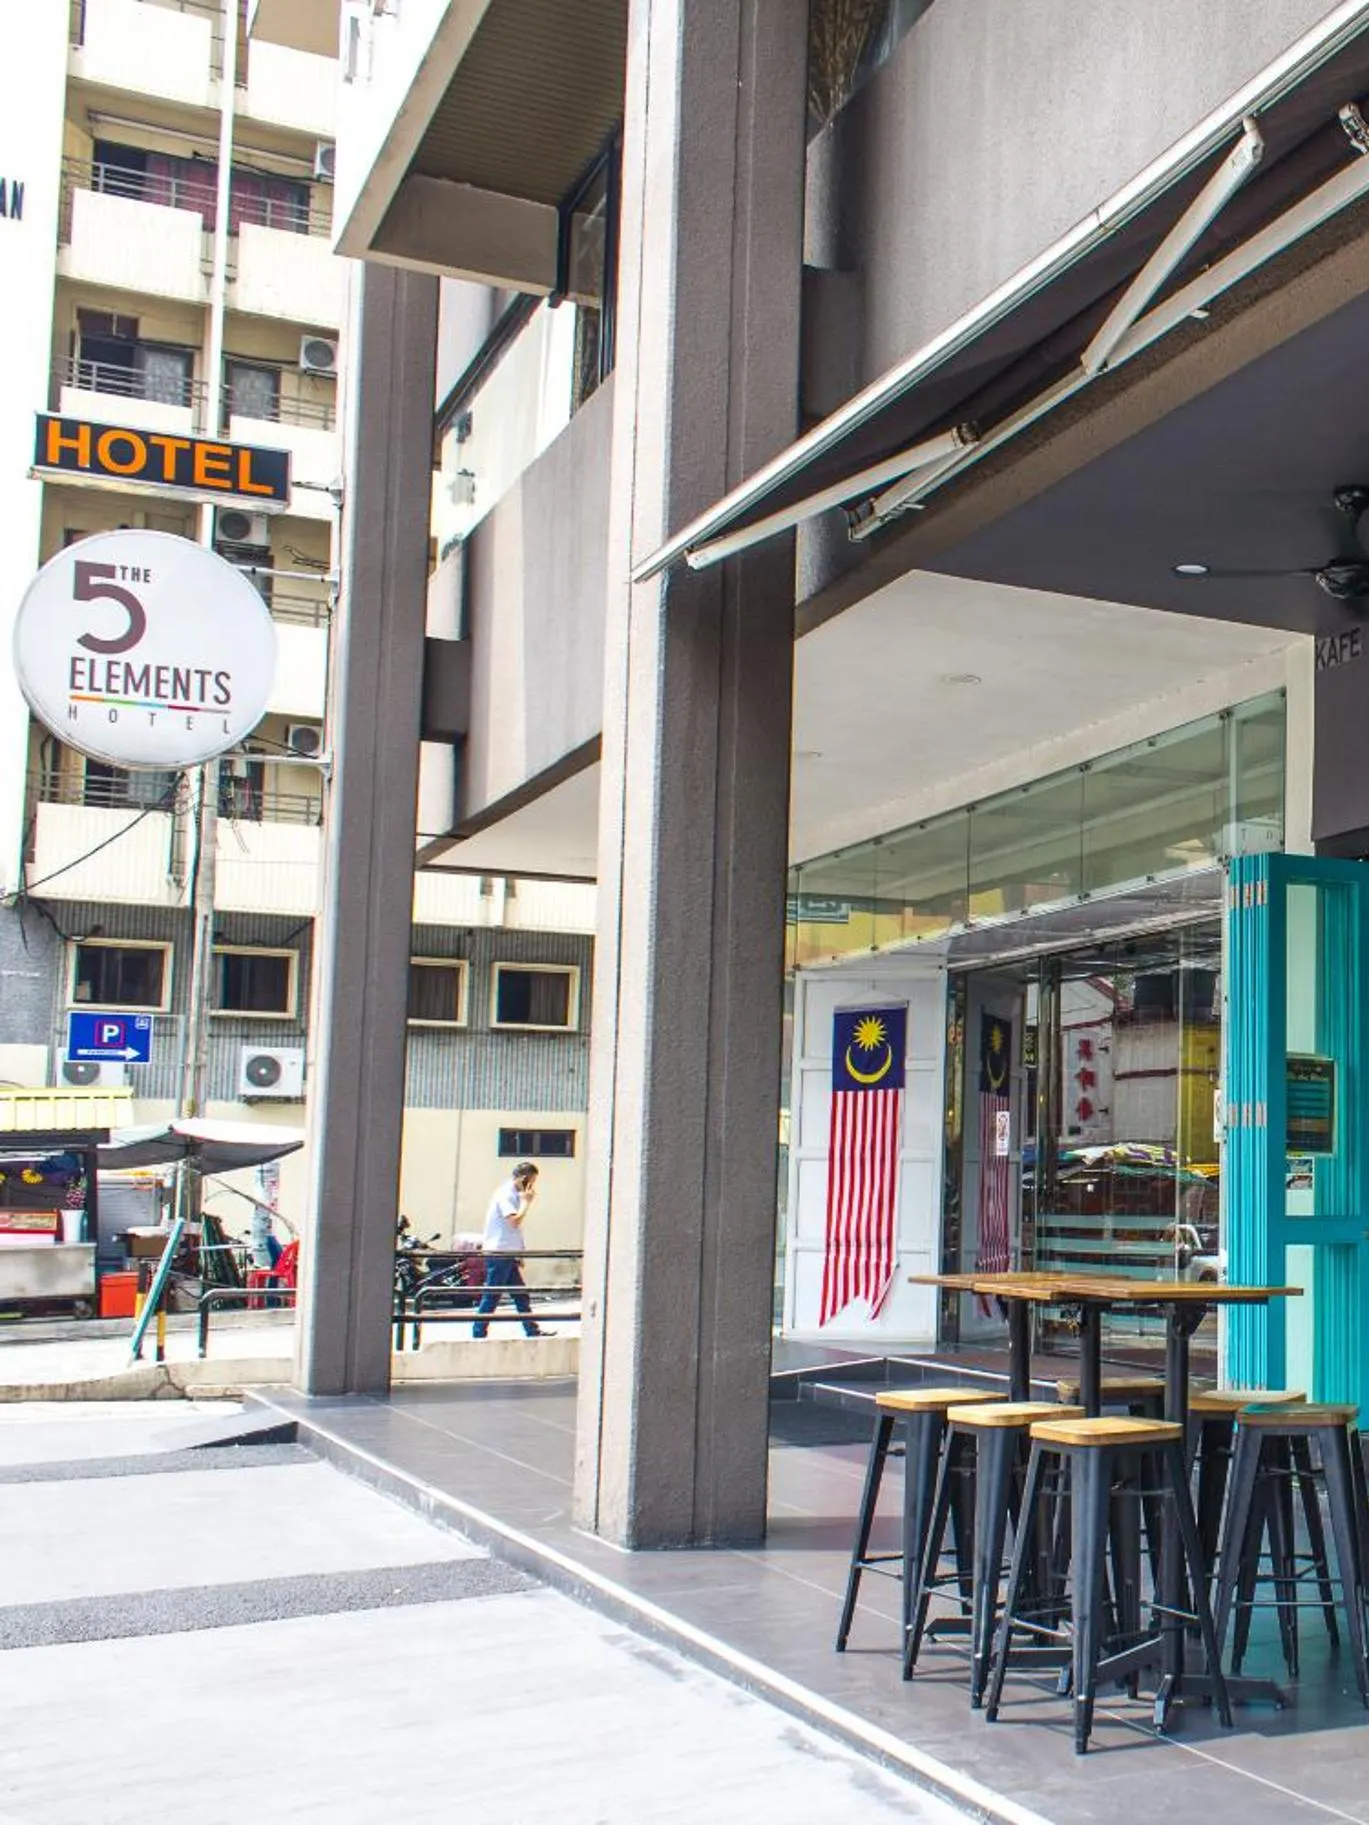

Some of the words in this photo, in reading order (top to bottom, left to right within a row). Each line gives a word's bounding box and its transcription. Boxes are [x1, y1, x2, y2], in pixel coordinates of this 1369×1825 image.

[47, 419, 275, 496] HOTEL
[120, 565, 151, 583] THE
[73, 560, 146, 655] 5
[1315, 627, 1361, 670] KAFE
[70, 656, 231, 705] ELEMENTS
[68, 704, 231, 734] HOTEL
[102, 1024, 120, 1043] P
